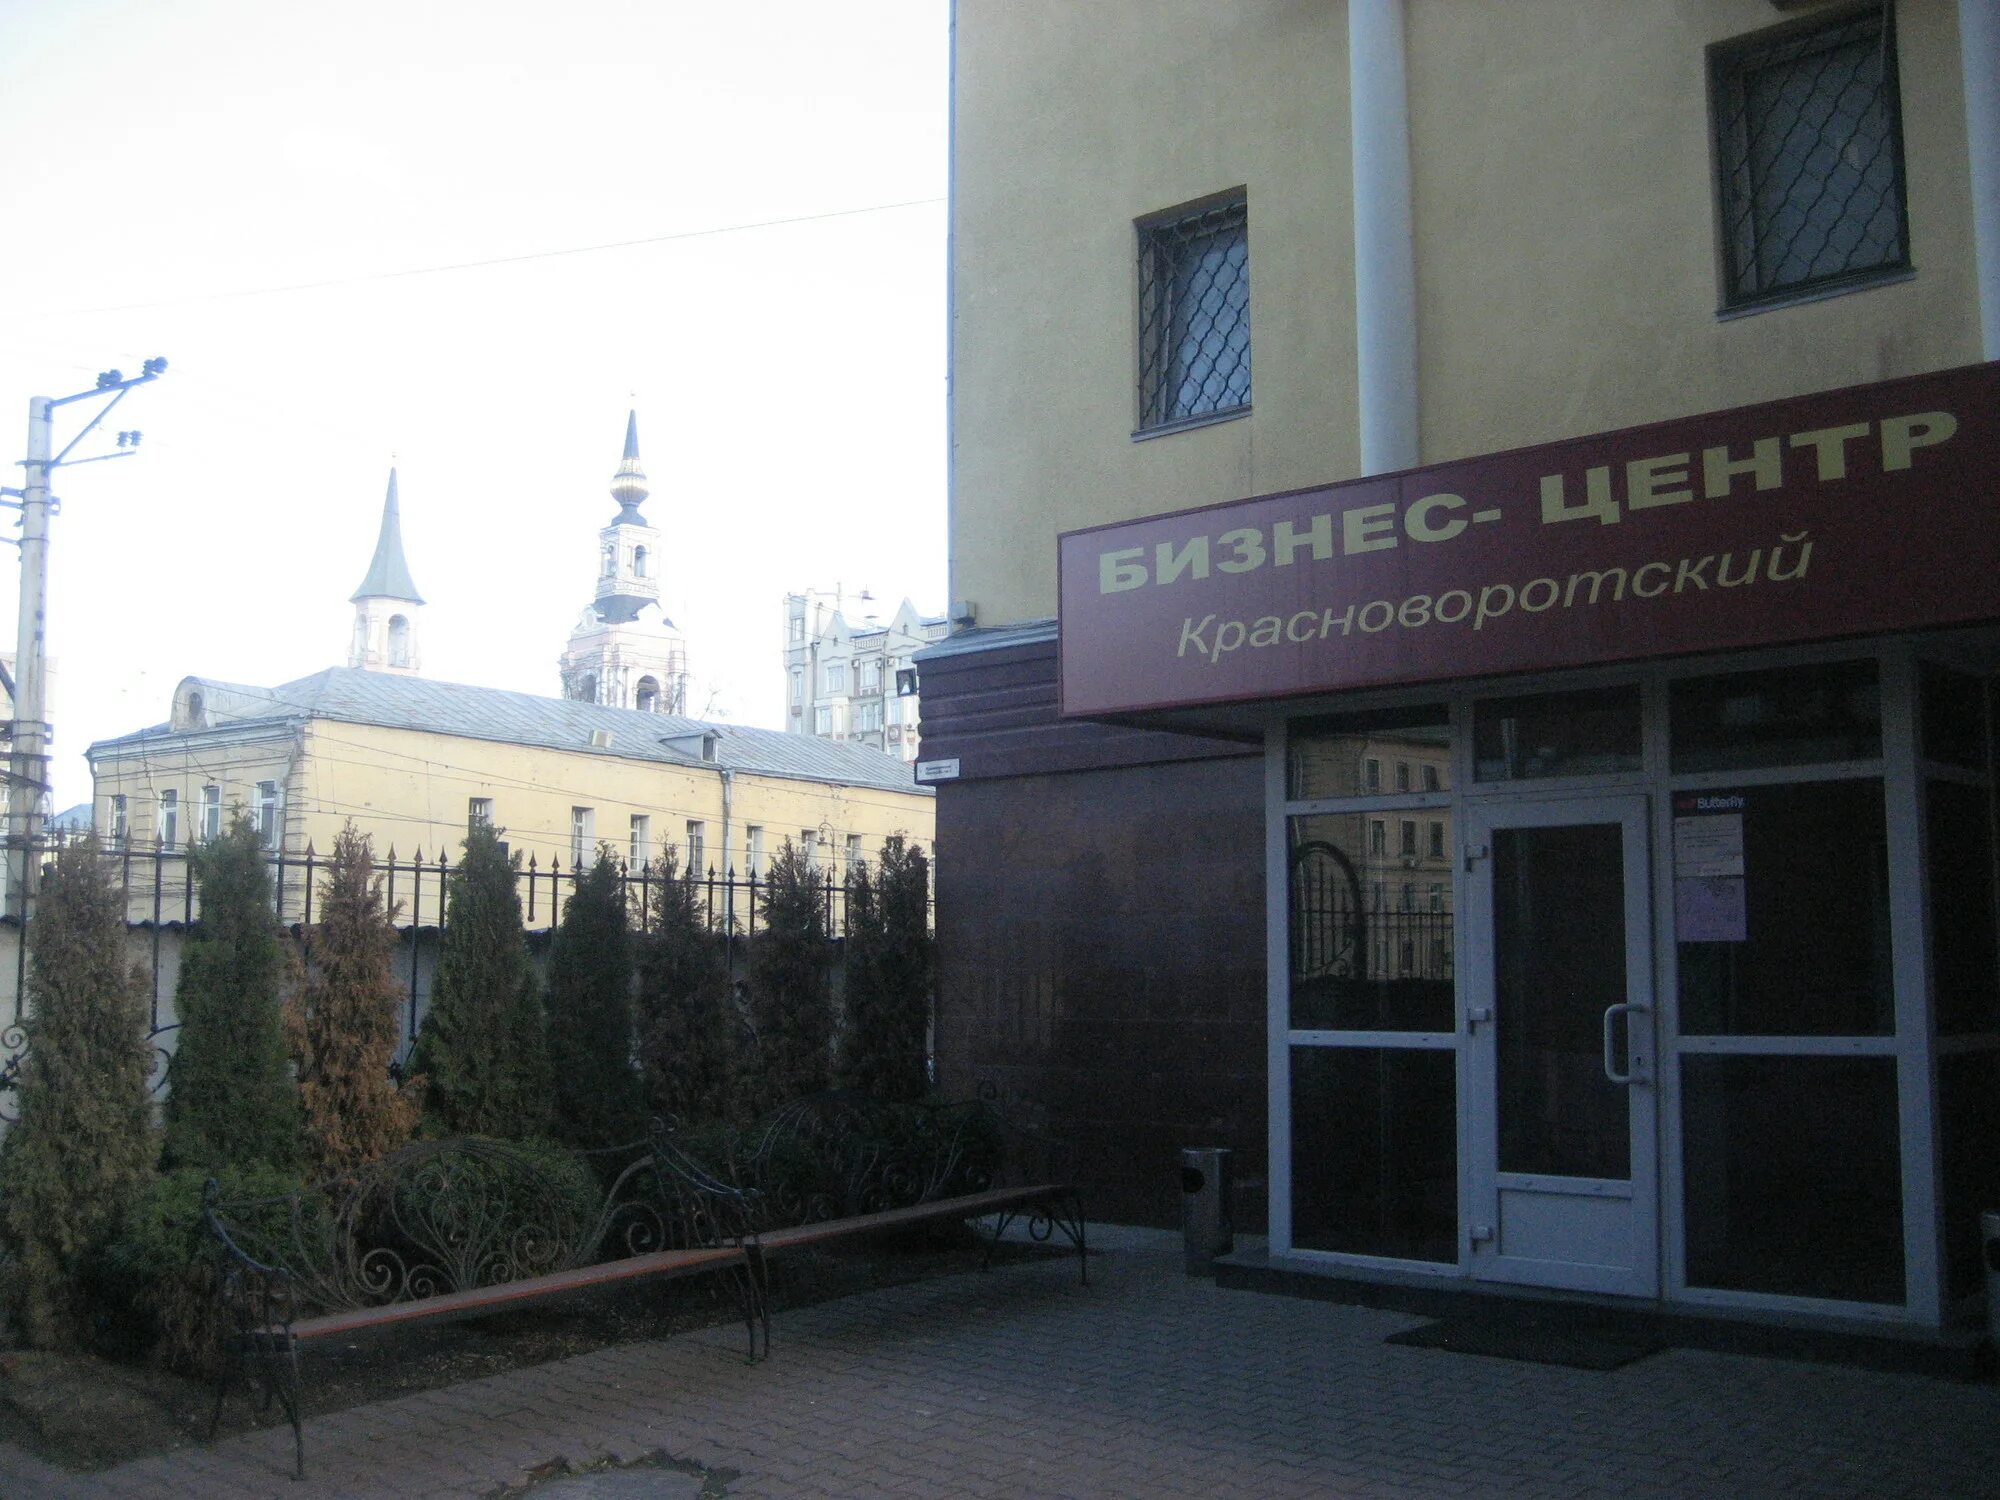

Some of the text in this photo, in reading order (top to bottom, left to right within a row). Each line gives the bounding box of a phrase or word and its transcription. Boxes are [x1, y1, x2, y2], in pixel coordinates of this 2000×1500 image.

[1099, 410, 1958, 595] БИЗНЕС- ЦЕНТР
[1175, 530, 1814, 664] Красноворотский
